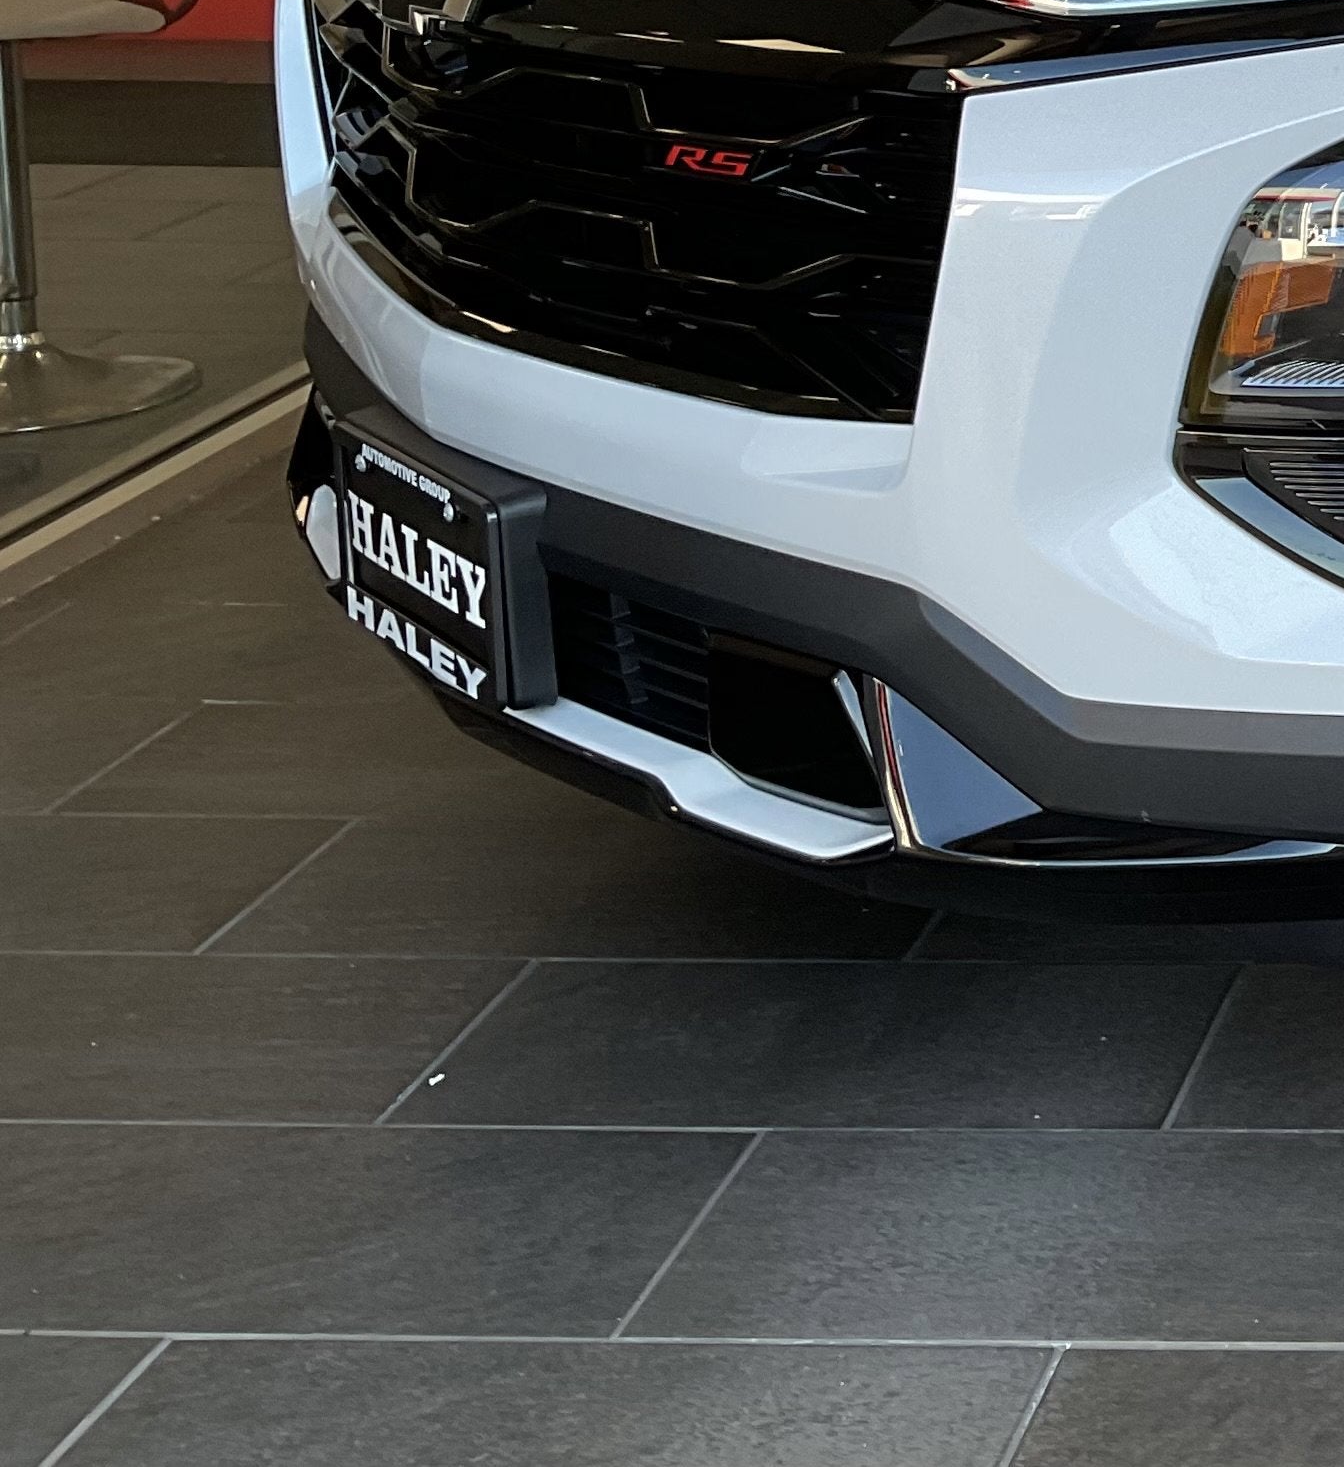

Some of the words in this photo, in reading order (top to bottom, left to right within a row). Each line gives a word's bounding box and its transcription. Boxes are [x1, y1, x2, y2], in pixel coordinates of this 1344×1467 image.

[664, 143, 754, 179] RS
[361, 442, 418, 488] AUTOMOTIVE
[418, 475, 451, 503] GROUP
[347, 488, 487, 630] HALEY
[346, 584, 488, 701] HALEY
